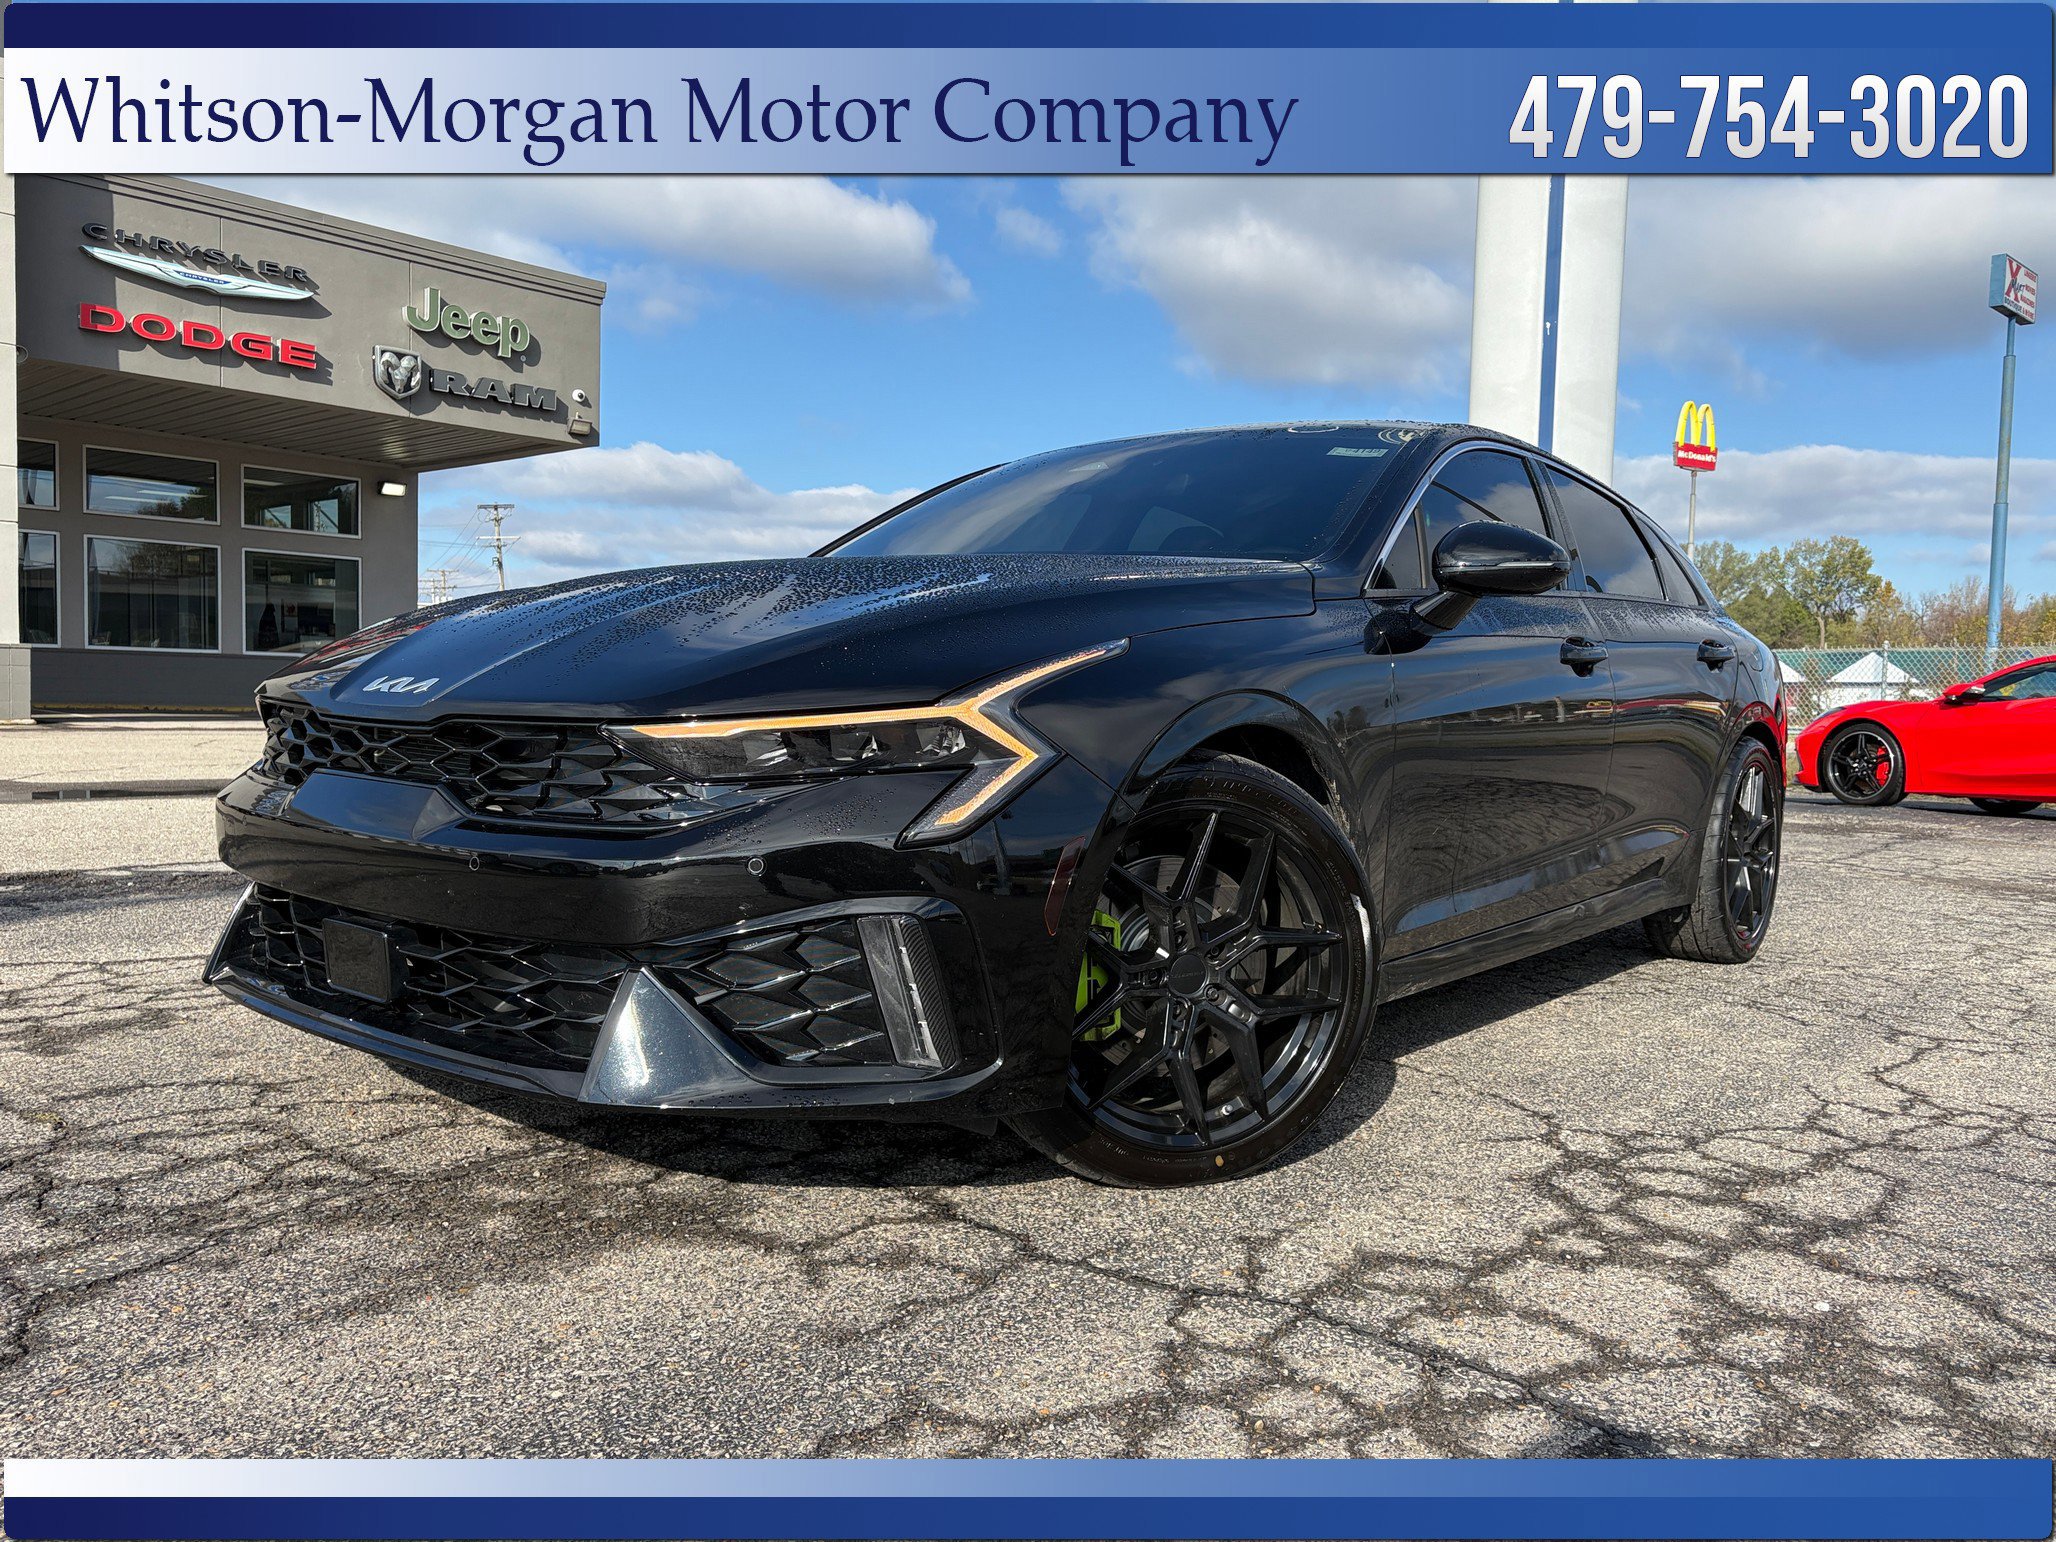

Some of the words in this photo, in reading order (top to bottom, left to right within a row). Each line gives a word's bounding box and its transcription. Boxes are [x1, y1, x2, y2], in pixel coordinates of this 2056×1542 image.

[82, 222, 308, 282] CHRYSLER
[179, 272, 225, 284] CHRYSLER
[79, 302, 317, 369] DODGE
[402, 287, 530, 358] Jeep
[429, 368, 557, 411] RAM
[1677, 450, 1717, 463] McDonald's
